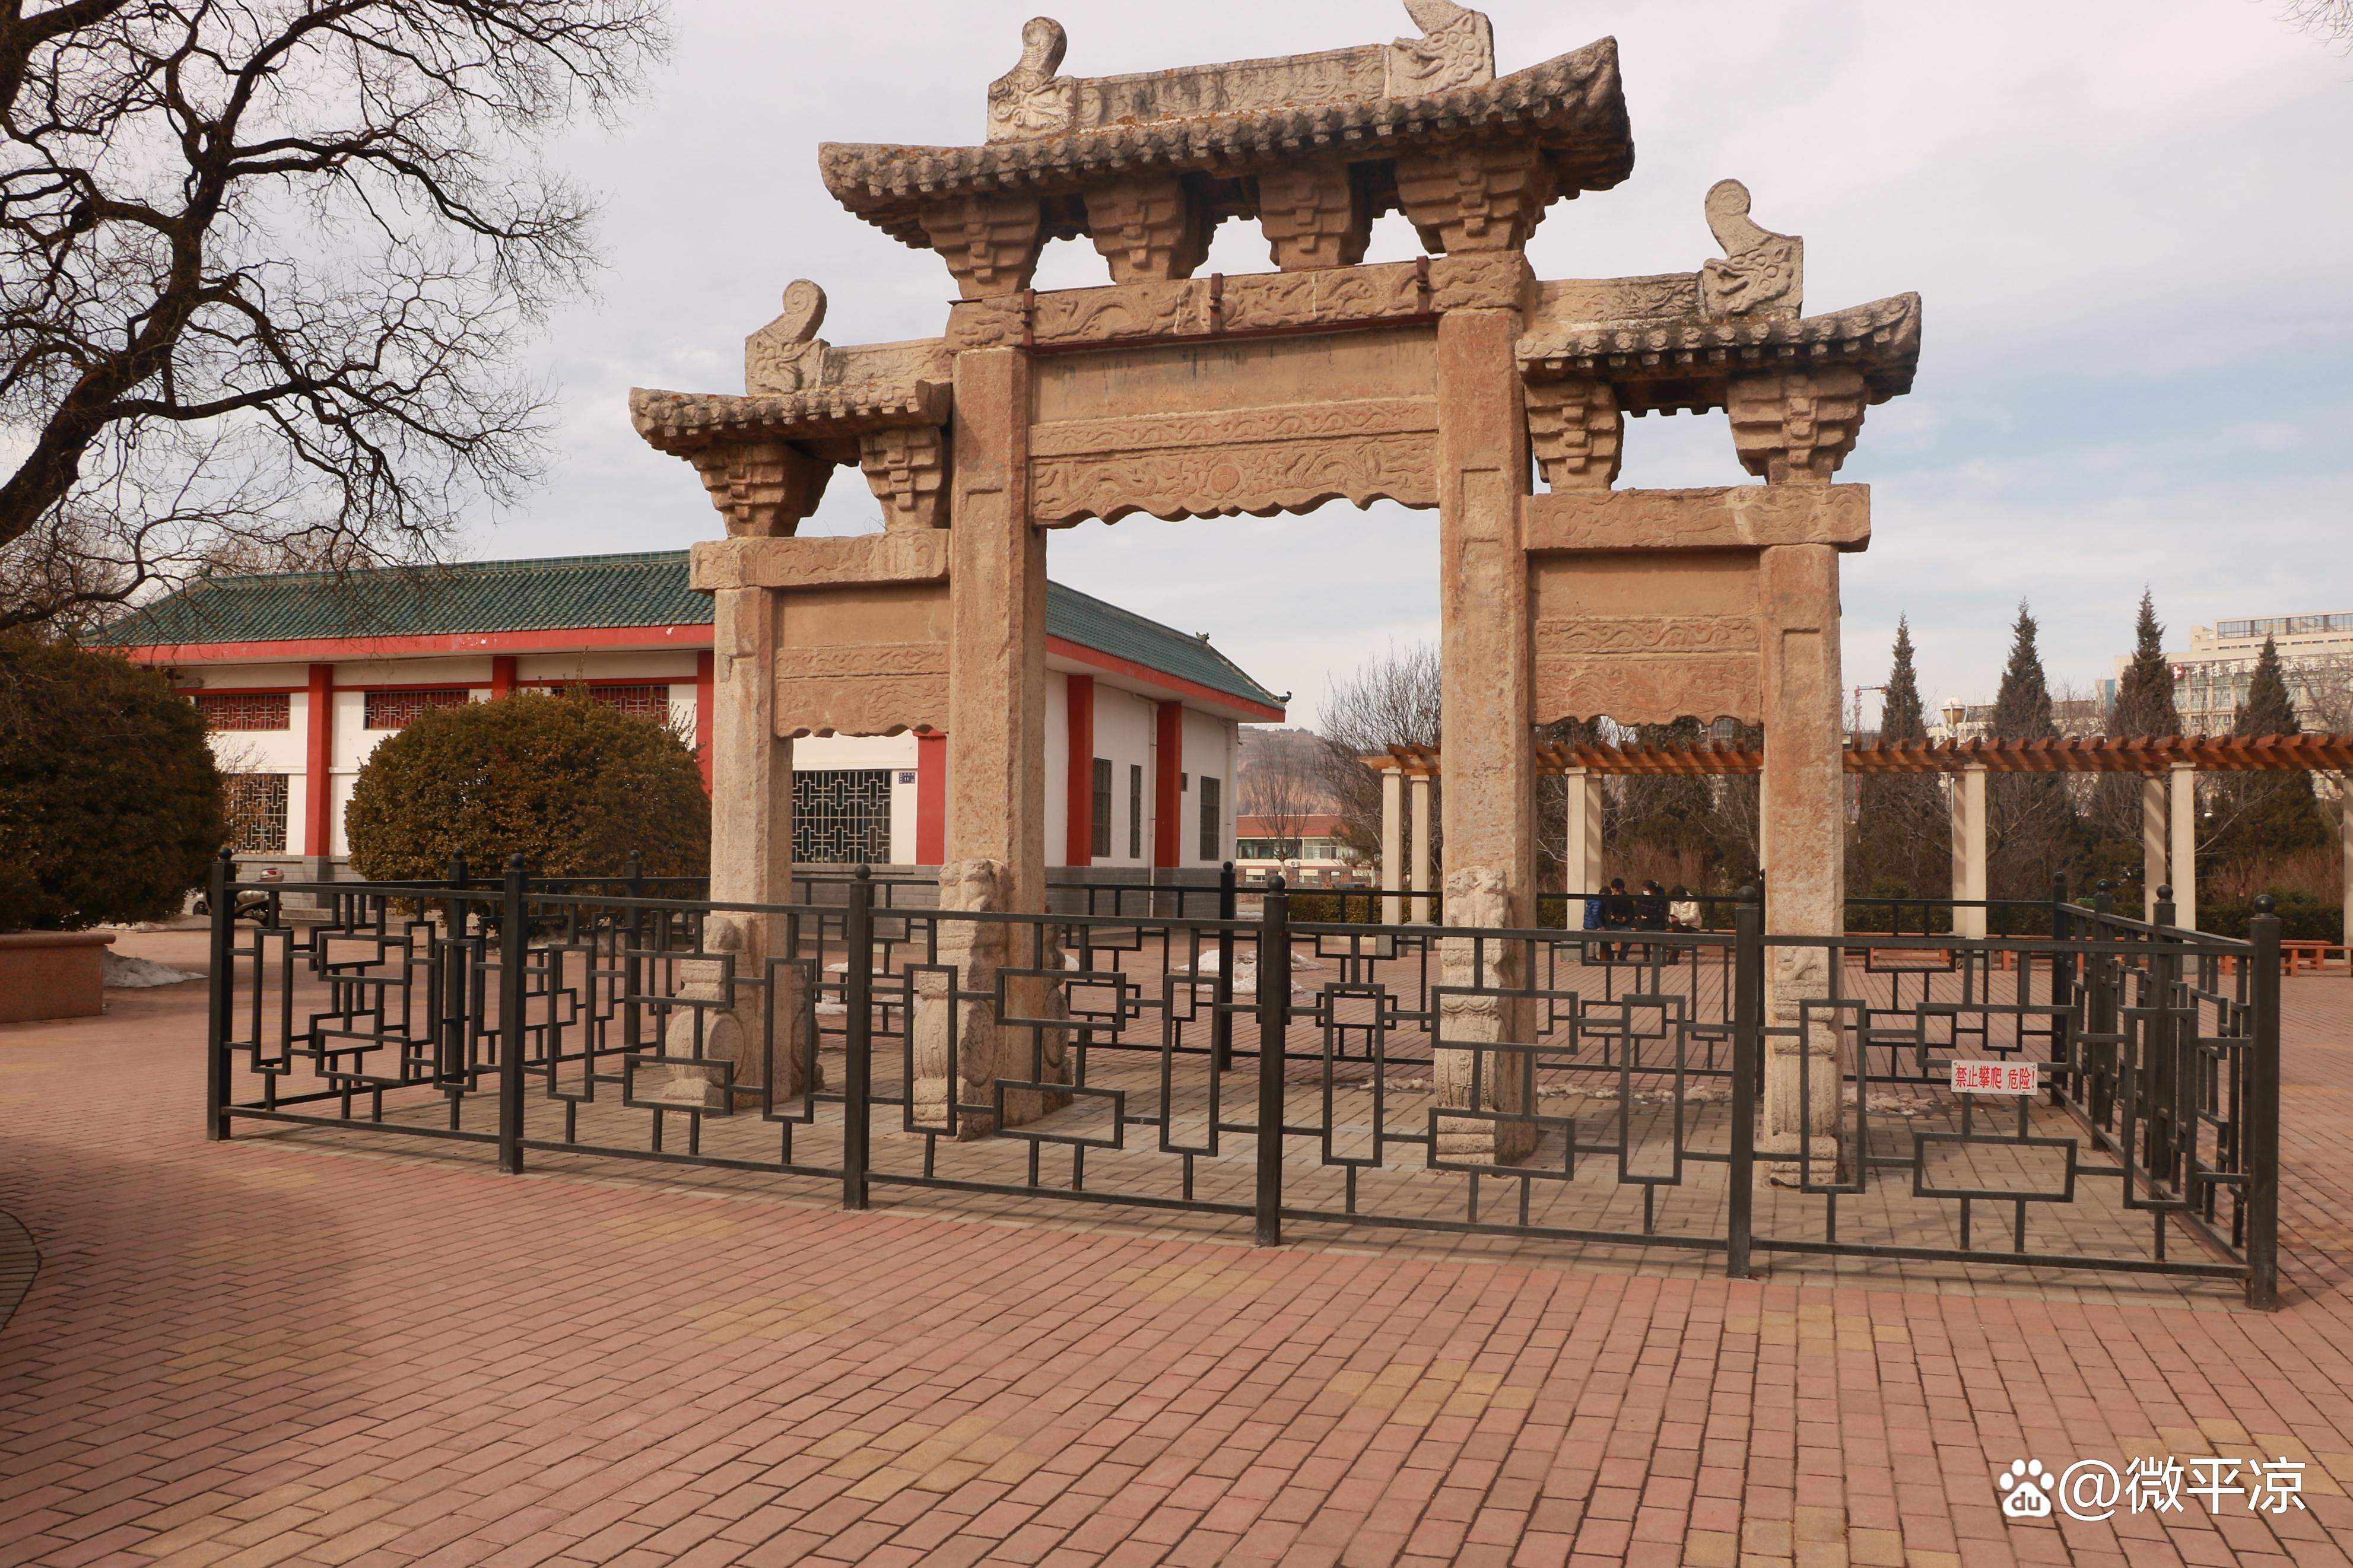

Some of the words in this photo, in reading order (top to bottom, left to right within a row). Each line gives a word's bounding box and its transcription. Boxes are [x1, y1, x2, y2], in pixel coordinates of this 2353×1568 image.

[2191, 655, 2321, 678] 平凉市医院
[1955, 1065, 2002, 1089] 禁止攀爬
